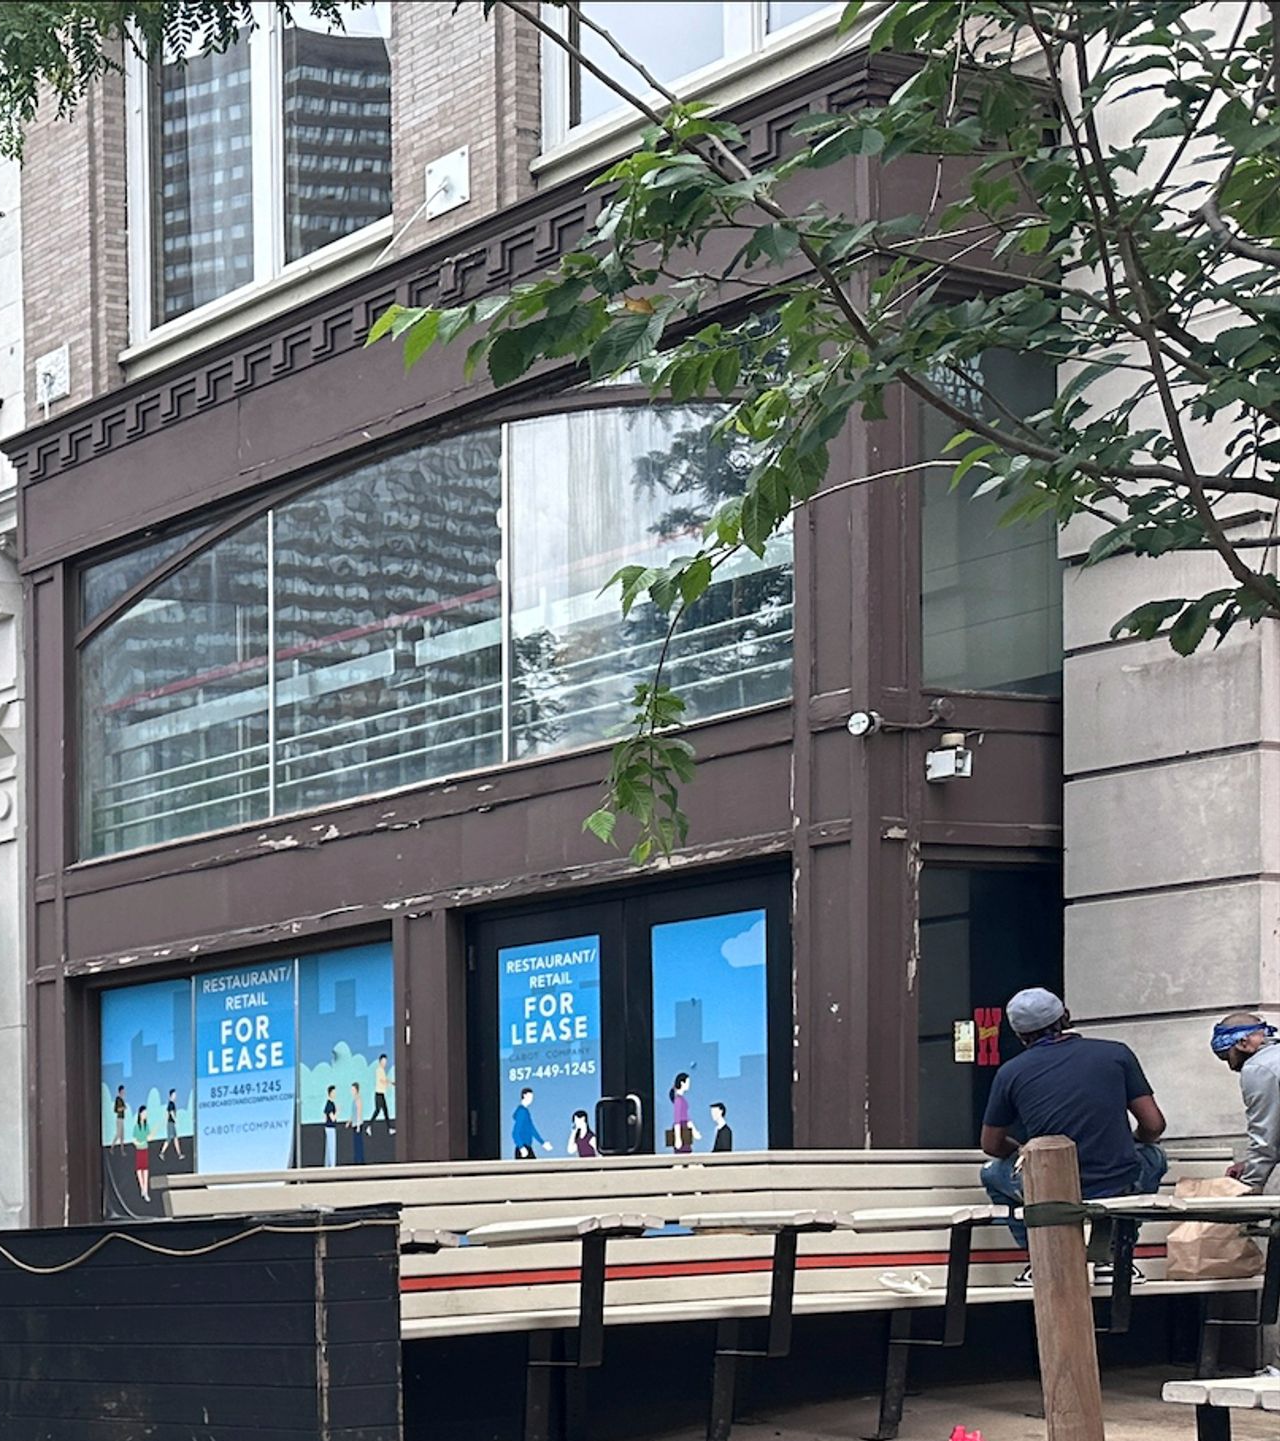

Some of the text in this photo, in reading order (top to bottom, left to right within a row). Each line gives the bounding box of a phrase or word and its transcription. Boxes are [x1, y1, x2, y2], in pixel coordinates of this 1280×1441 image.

[505, 947, 598, 974] RESTAURANT/
[202, 965, 293, 994] RESTAURANT/
[528, 972, 573, 989] RETAIL
[224, 991, 269, 1012] RETAIL
[524, 992, 574, 1019] FOR
[220, 1015, 270, 1046] FOR
[511, 1015, 588, 1046] LEASE
[207, 1041, 284, 1075] LEASE
[508, 1060, 596, 1082] 857-449-1245
[210, 1079, 282, 1099] 857-449-1245
